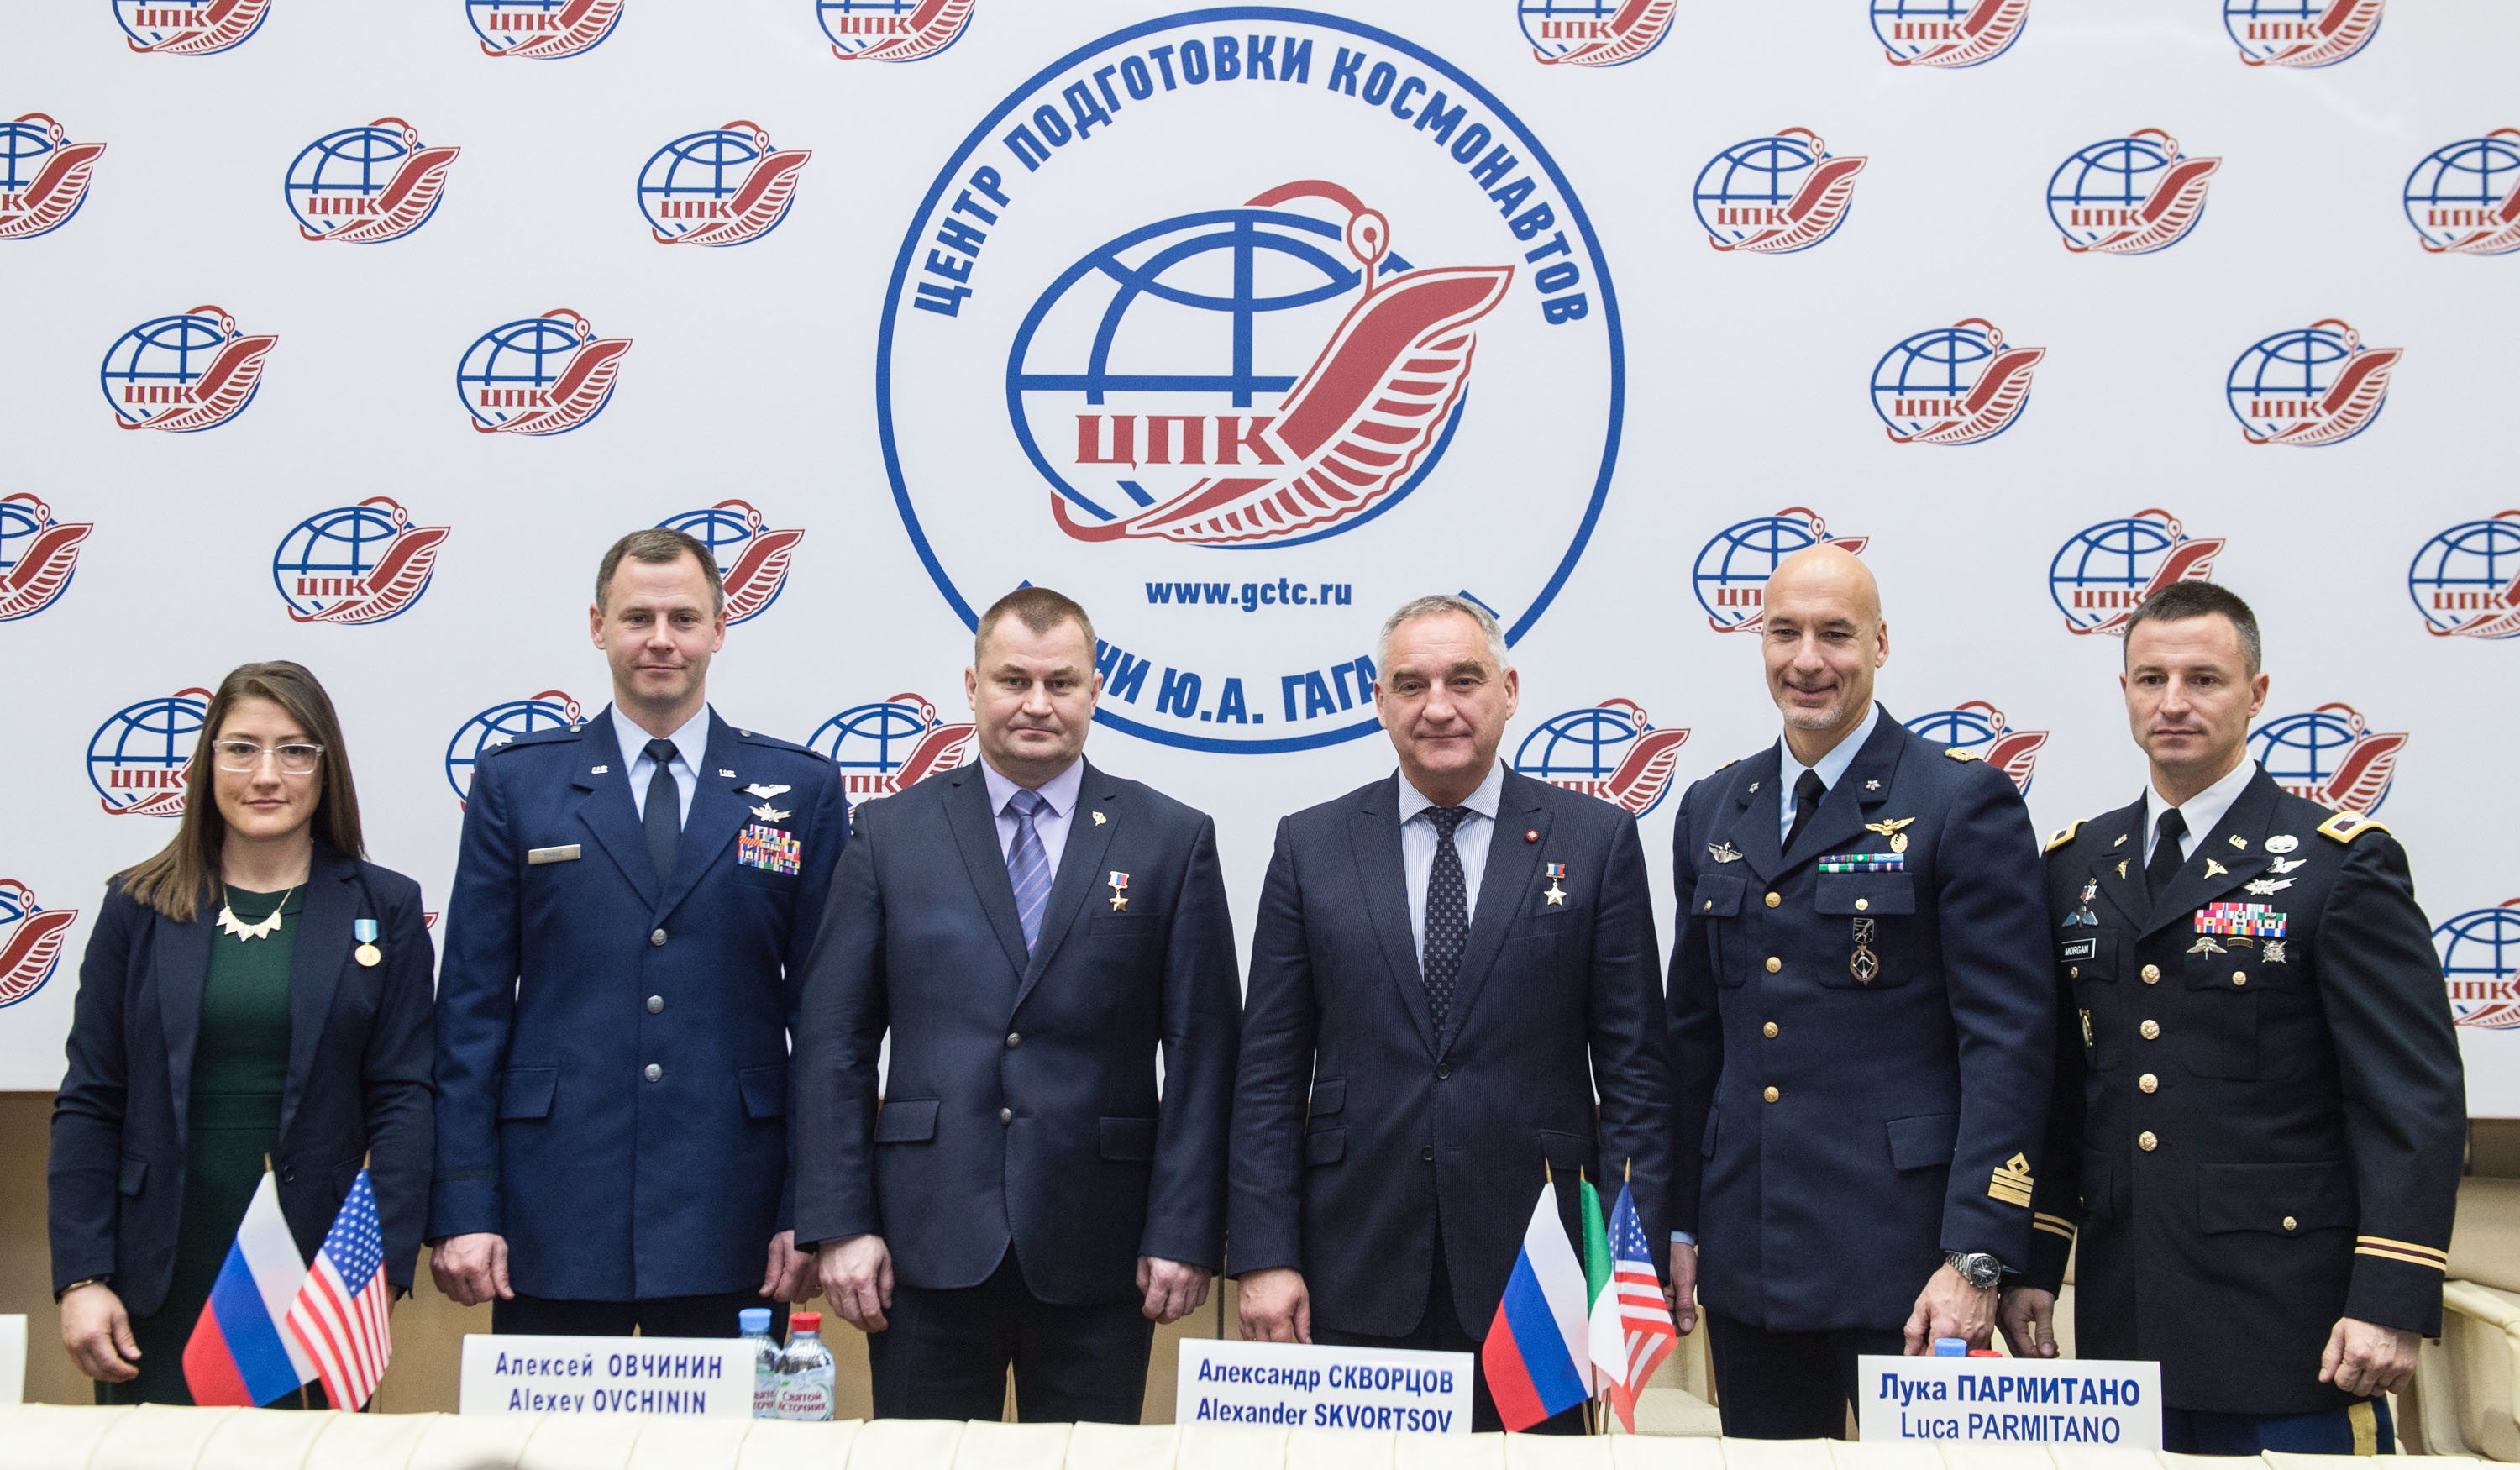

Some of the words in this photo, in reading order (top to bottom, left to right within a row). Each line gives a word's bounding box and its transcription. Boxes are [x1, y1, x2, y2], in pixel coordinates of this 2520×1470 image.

[135, 9, 207, 29] ЦПК
[489, 13, 560, 34] ЦПК
[840, 17, 911, 37] ЦПК
[1541, 21, 1612, 41] ЦПК
[1893, 23, 1964, 42] ЦПК
[2247, 23, 2318, 42] ЦПК
[913, 165, 1011, 318] ЦЕНТР
[1002, 34, 1313, 173] ПОДГОТОВКИ
[1326, 45, 1589, 326] КОСМОНАВТОВ
[308, 197, 380, 218] ЦПК
[660, 201, 732, 221] ЦПК
[1717, 207, 1788, 228] ЦПК
[2071, 209, 2142, 228] ЦПК
[2428, 209, 2499, 228] ЦПК
[124, 386, 197, 407] ЦПК
[480, 389, 552, 411] ЦПК
[1894, 399, 1966, 419] ЦПК
[2250, 400, 2323, 420] ЦПК
[1074, 414, 1285, 471] ЦПК
[297, 577, 370, 598] ЦПК
[1145, 577, 1352, 613] www.gctc.ru
[1717, 588, 1762, 608] ЦП
[2073, 591, 2143, 611] ЦПК
[2433, 592, 2506, 612] ЦПК
[1281, 654, 1378, 725] ГАГА
[110, 769, 184, 791] ЦПК
[2064, 944, 2089, 956] MORGAN
[495, 1352, 593, 1377] Алексей
[608, 1353, 722, 1379] ОВЧИНИН
[1198, 1358, 1321, 1393] Александр
[1329, 1365, 1454, 1397] СКВОРЦОВ
[1879, 1373, 1948, 1407] Лука
[1957, 1375, 2140, 1406] ПАРМИТАНО
[509, 1388, 585, 1414] Alexey
[593, 1389, 706, 1414] OVCHININ
[1196, 1398, 1308, 1426] Alexander
[1314, 1404, 1453, 1433] SKVORTSOV
[1901, 1411, 1960, 1439] Luca
[1968, 1413, 2121, 1444] PARMITANO
